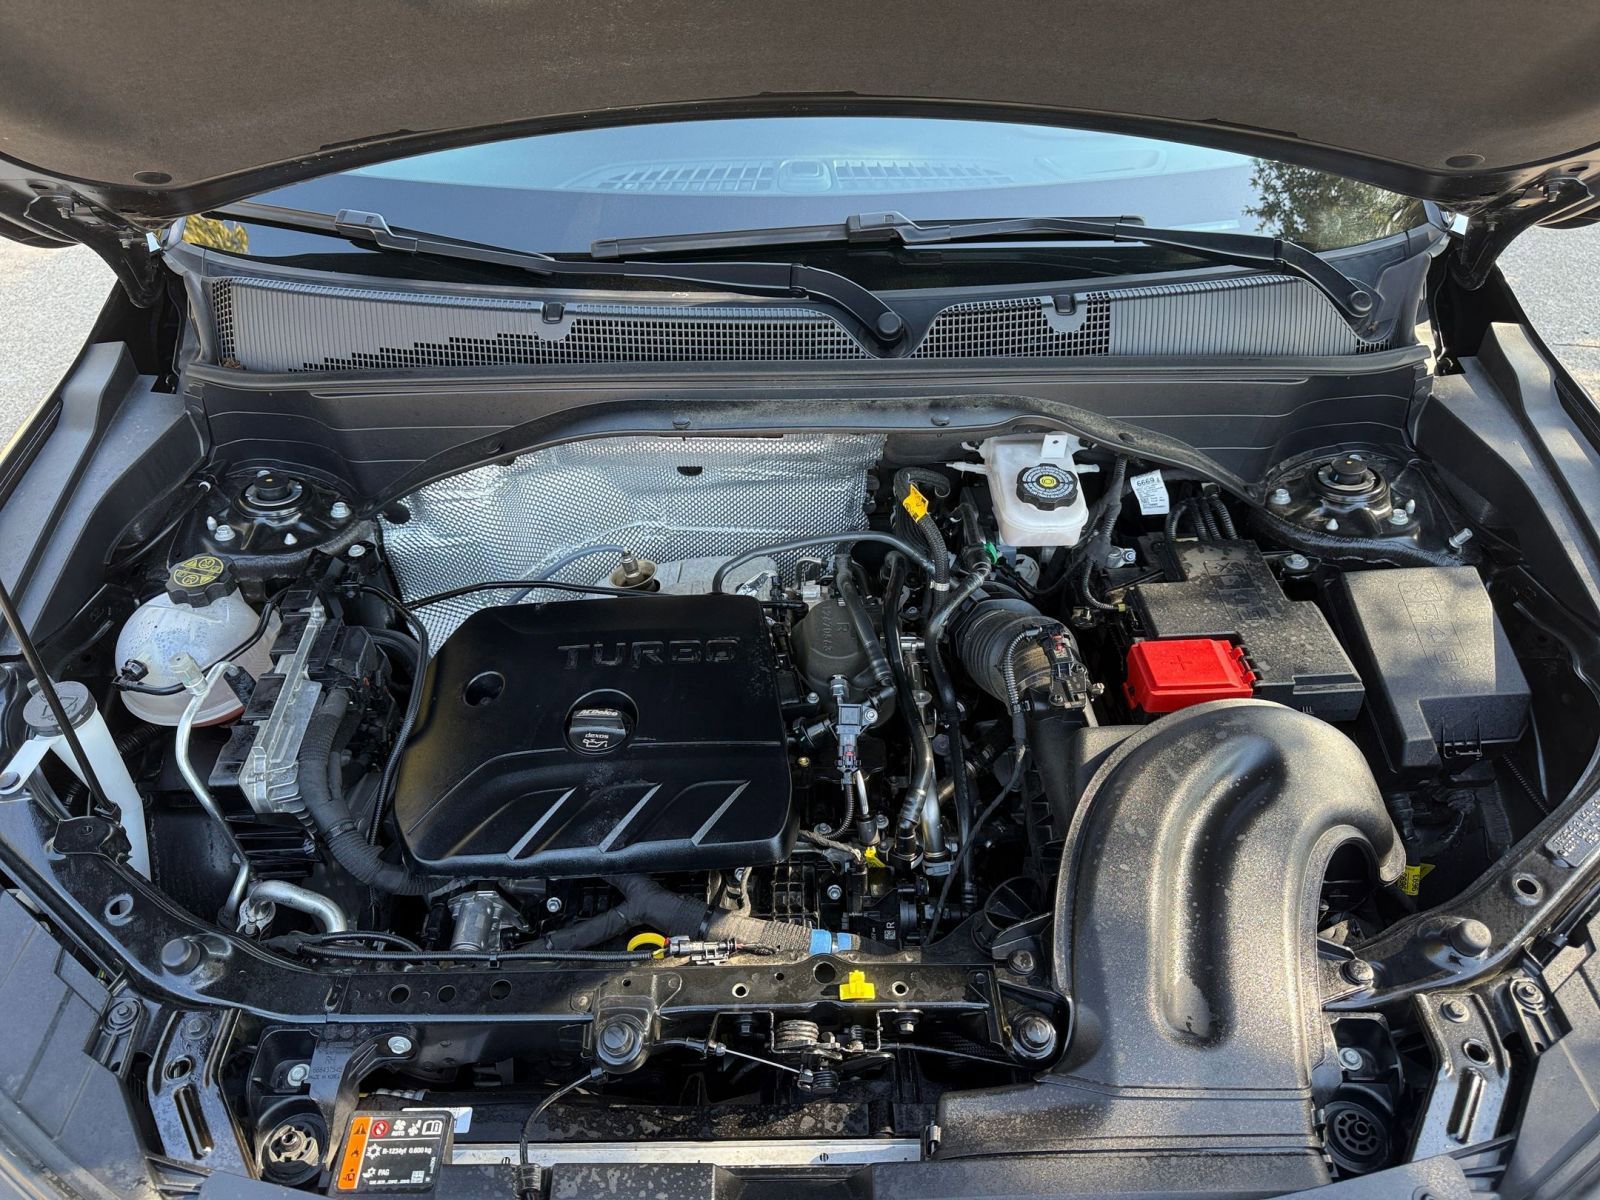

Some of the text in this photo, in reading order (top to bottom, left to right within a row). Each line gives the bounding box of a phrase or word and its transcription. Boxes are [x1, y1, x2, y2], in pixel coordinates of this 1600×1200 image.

[558, 638, 738, 670] TURBO
[576, 709, 619, 717] ACDelco
[377, 1168, 390, 1176] PAG
